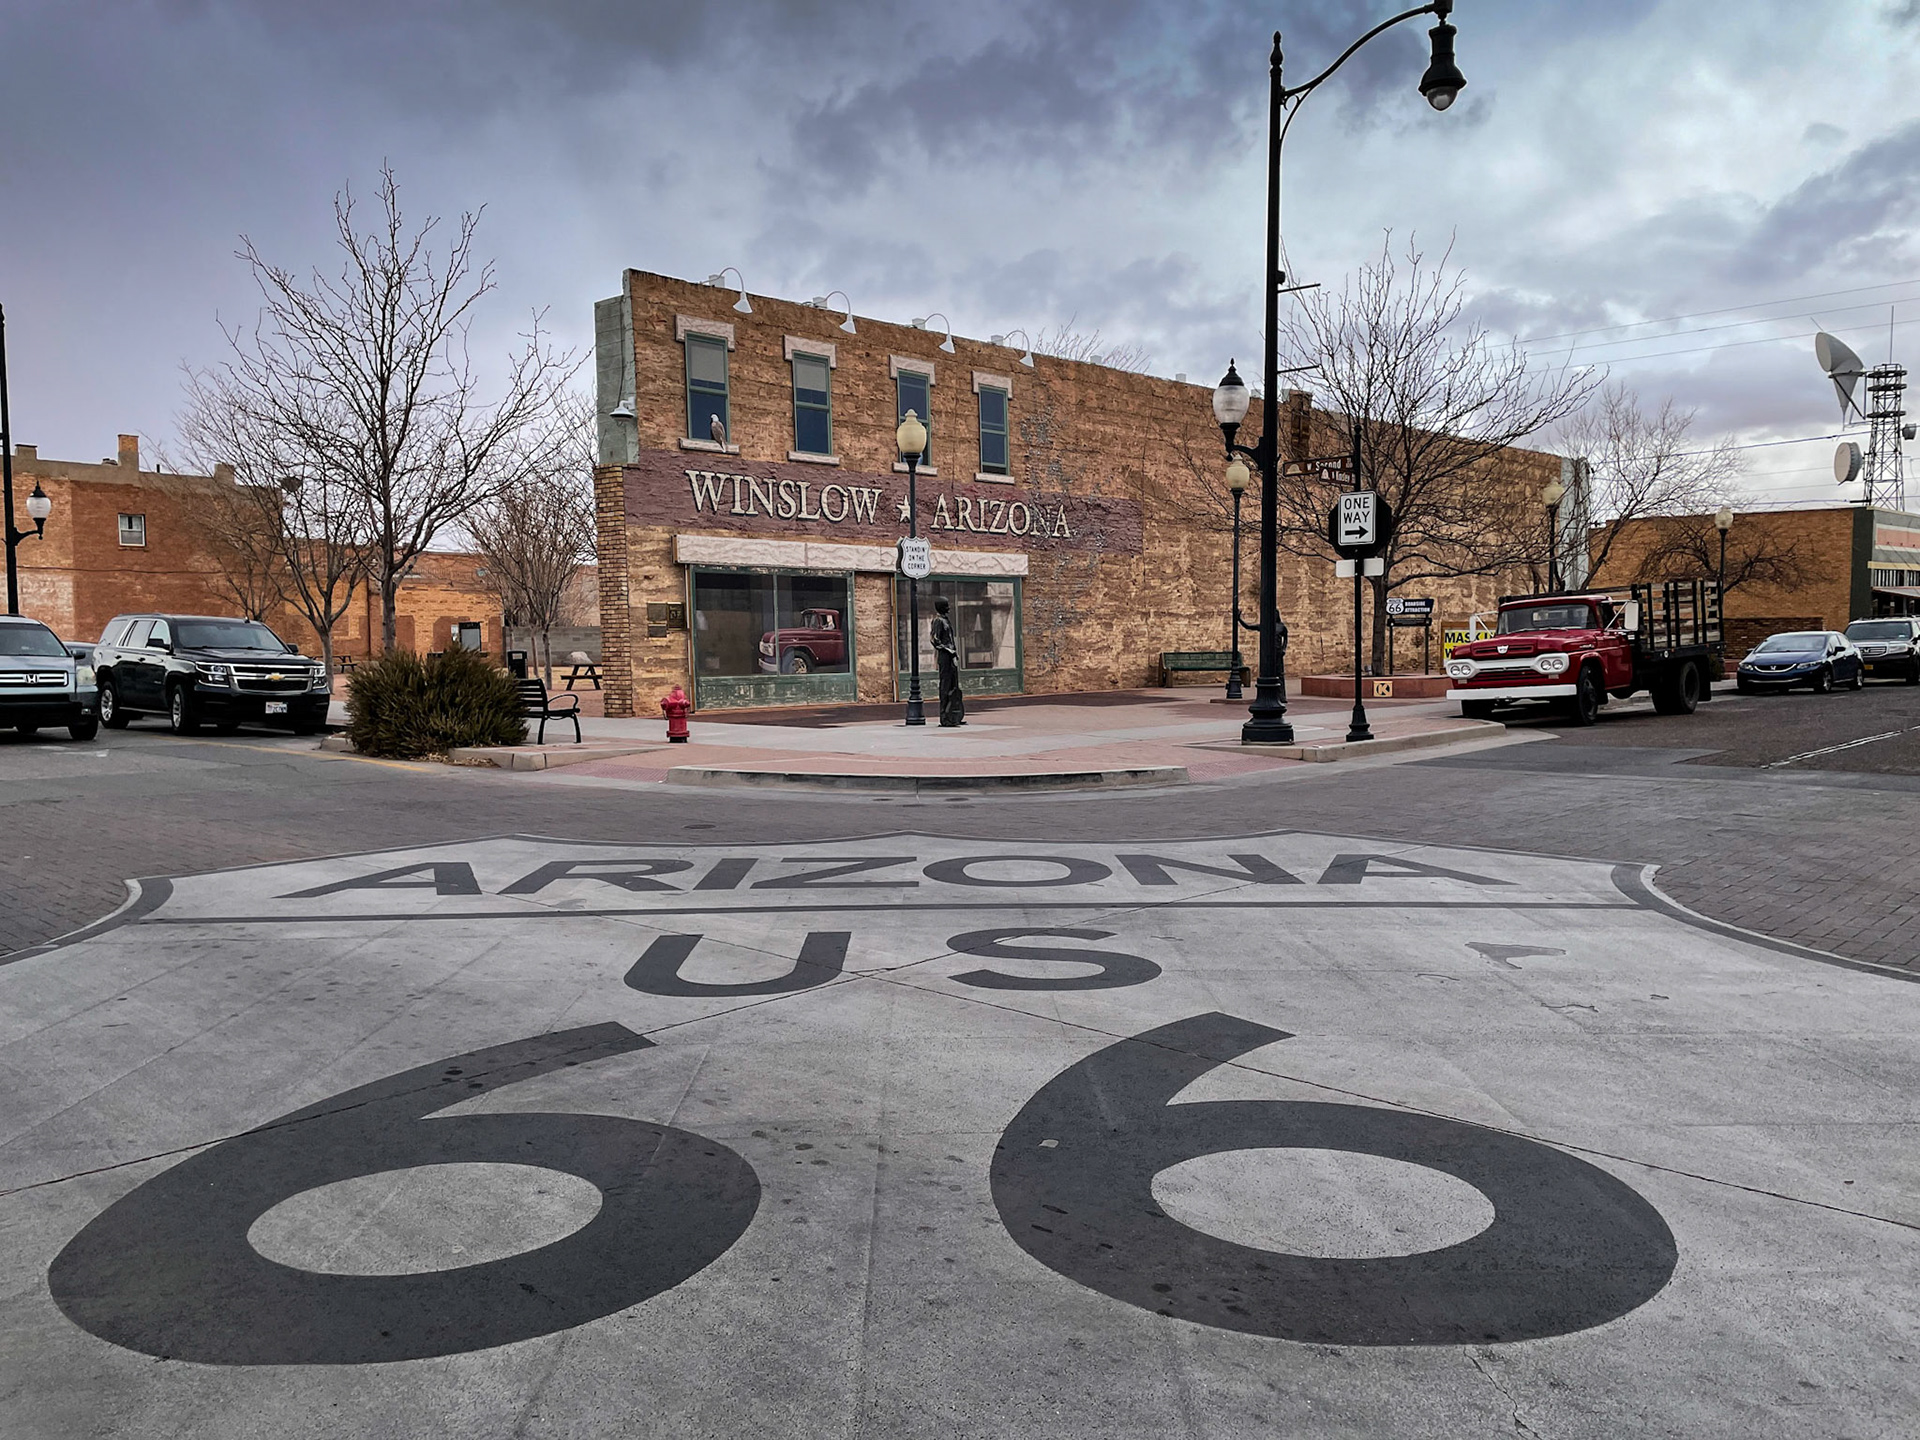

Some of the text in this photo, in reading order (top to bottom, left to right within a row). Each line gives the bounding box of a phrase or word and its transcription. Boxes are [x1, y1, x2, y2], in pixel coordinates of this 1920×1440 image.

[684, 470, 1071, 539] WINSLOW ARIZONA
[1344, 497, 1370, 510] ONE
[1343, 511, 1370, 524] WAY
[907, 562, 926, 570] CORNER
[1389, 603, 1402, 613] 66
[273, 853, 1521, 899] ARIZONA
